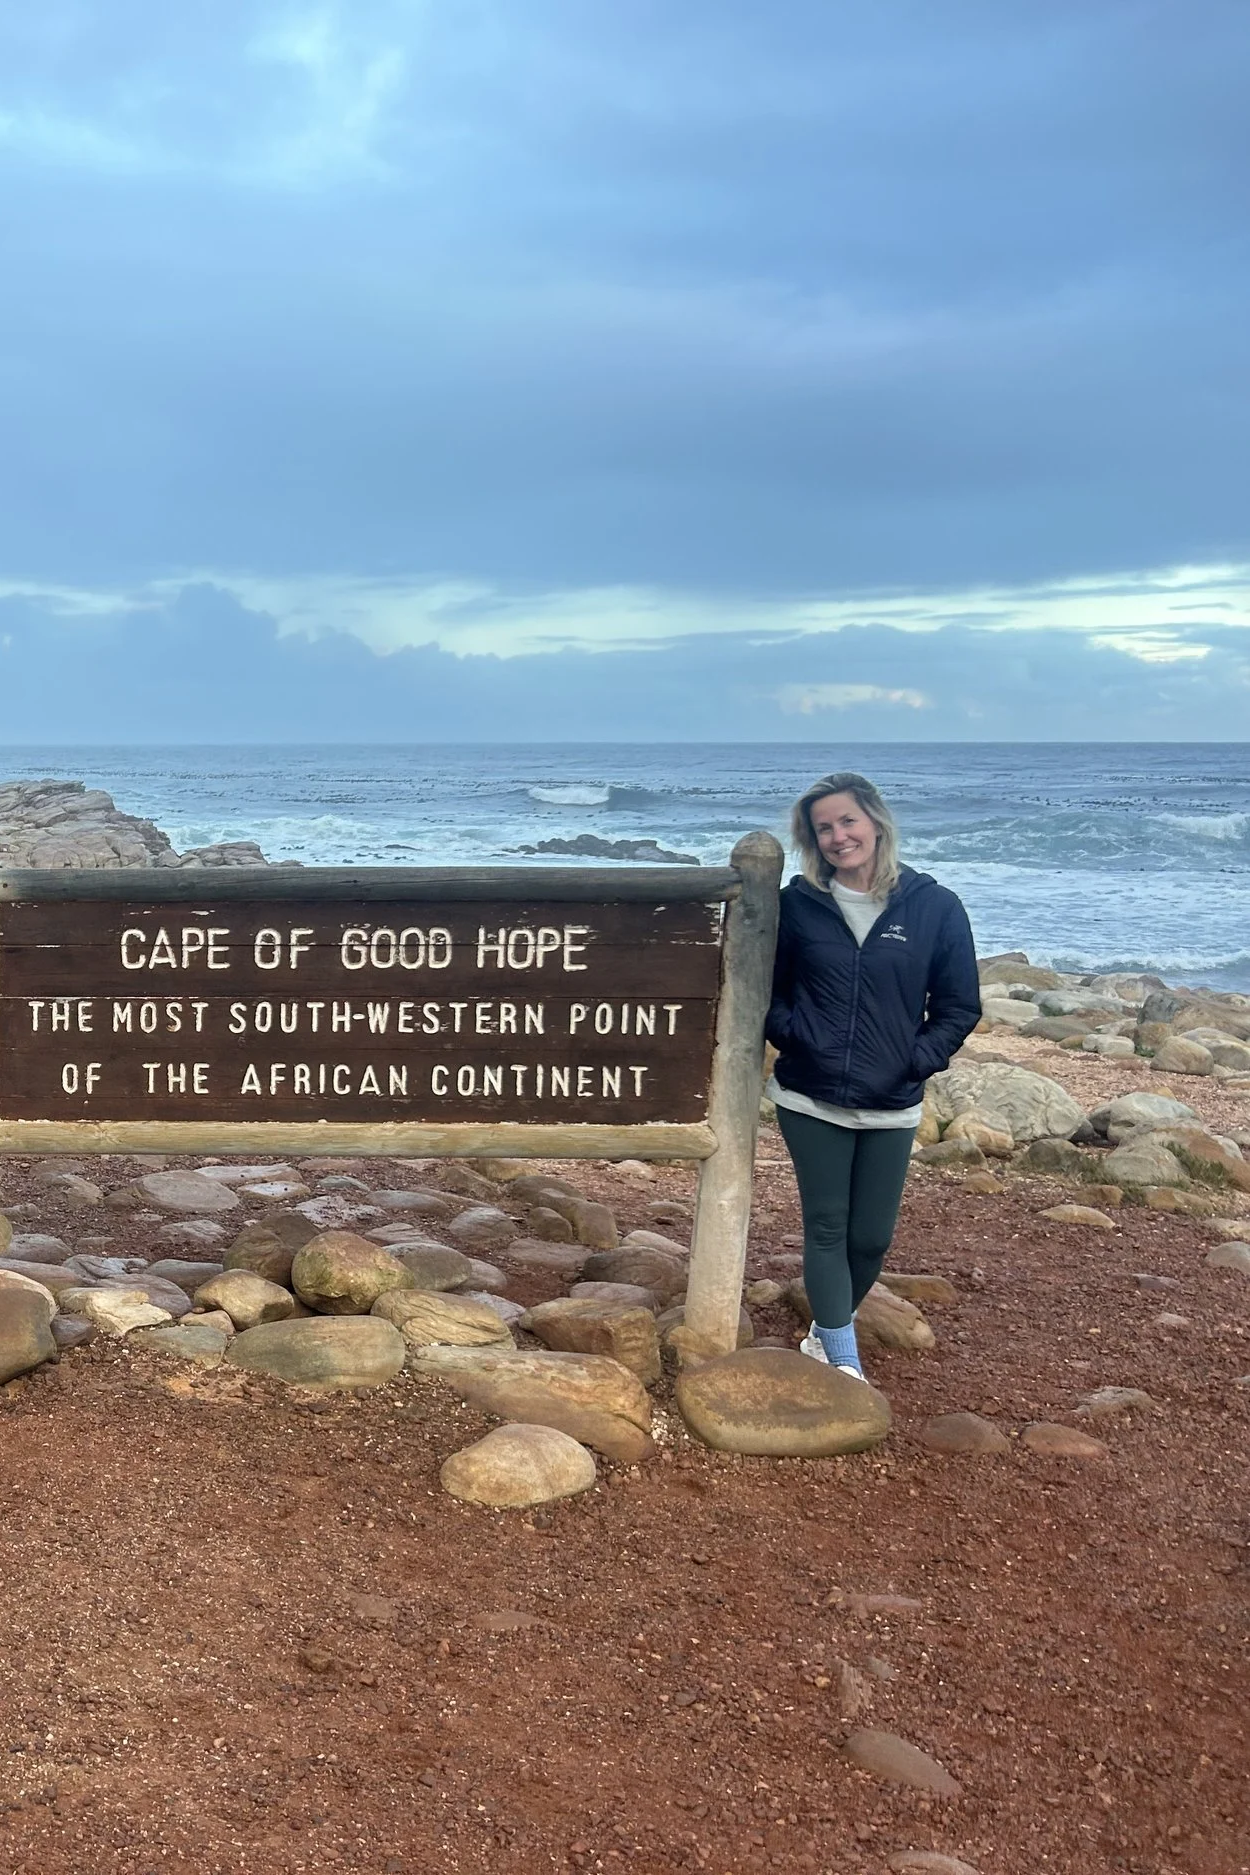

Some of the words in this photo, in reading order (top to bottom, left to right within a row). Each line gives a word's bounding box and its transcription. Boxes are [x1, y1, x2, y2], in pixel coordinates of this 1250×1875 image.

[120, 927, 231, 970] CAPE
[254, 927, 314, 970] OF
[341, 927, 453, 971] GOOD
[477, 925, 589, 972] HOPE
[28, 1000, 94, 1034] THE
[111, 1000, 210, 1034] MOST
[228, 1001, 545, 1035] SOUTH-WESTERN
[569, 1002, 684, 1036] POINT
[61, 1062, 102, 1095] OF
[141, 1062, 210, 1094] THE
[240, 1062, 408, 1096] AFRICAN
[431, 1063, 649, 1098] CONTINENT
